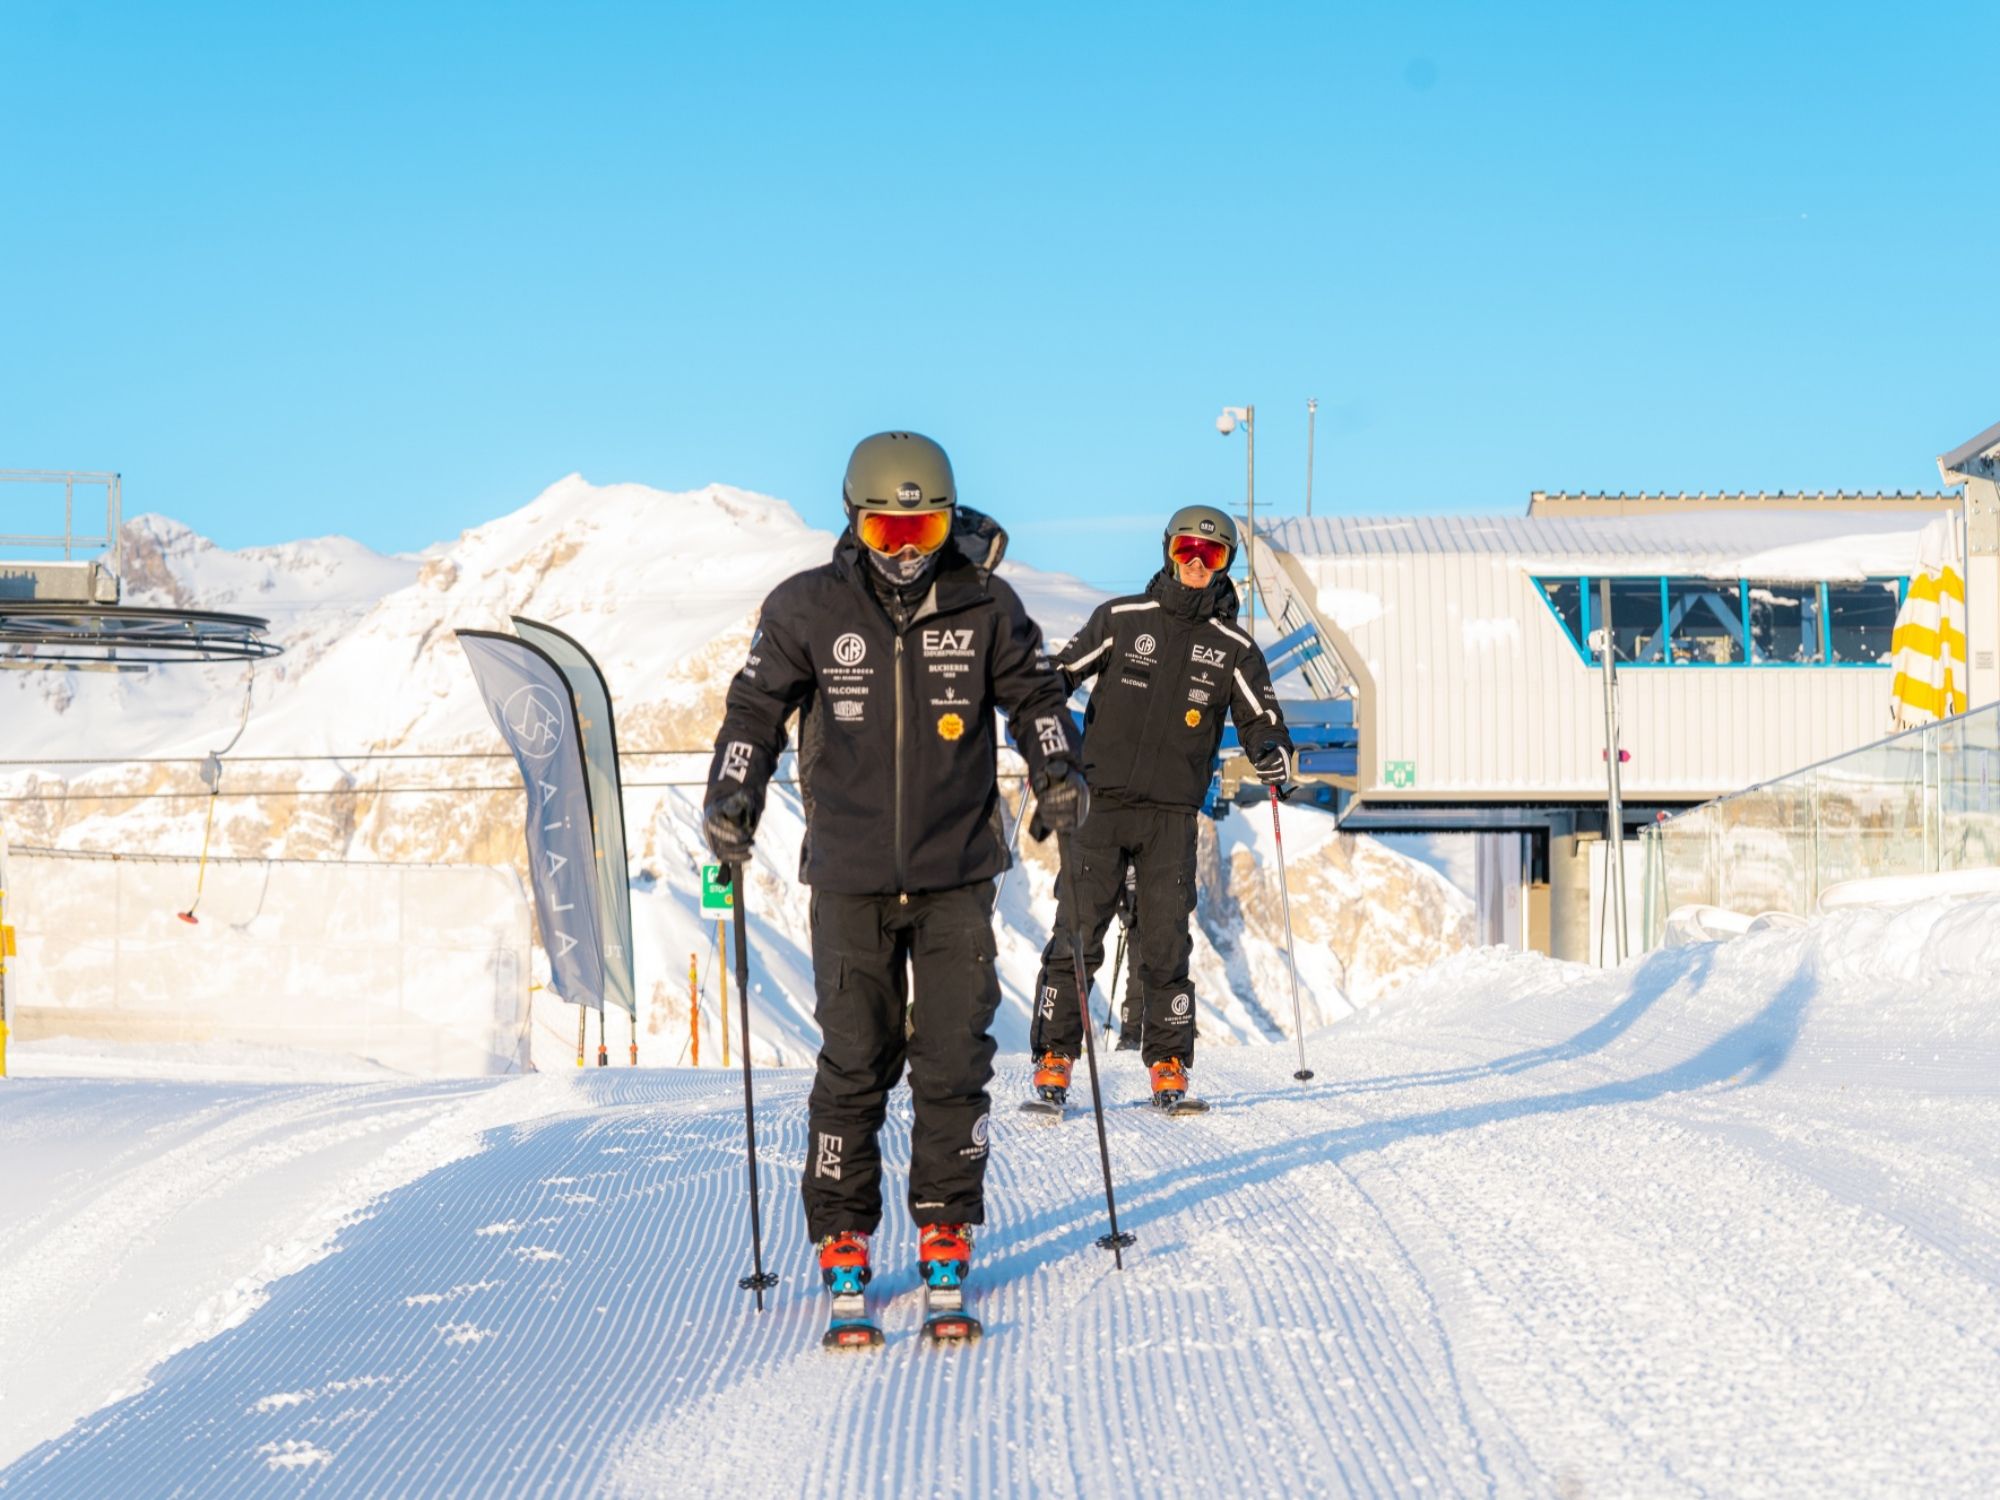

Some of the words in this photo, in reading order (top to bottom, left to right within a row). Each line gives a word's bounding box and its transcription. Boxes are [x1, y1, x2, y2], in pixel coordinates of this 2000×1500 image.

[922, 629, 974, 650] EA7
[1192, 644, 1227, 663] EA7
[828, 686, 869, 695] FALCONERI
[1035, 717, 1063, 756] EA7
[726, 741, 753, 784] EA7
[1042, 986, 1057, 1021] EA7
[822, 1133, 843, 1181] EA7
